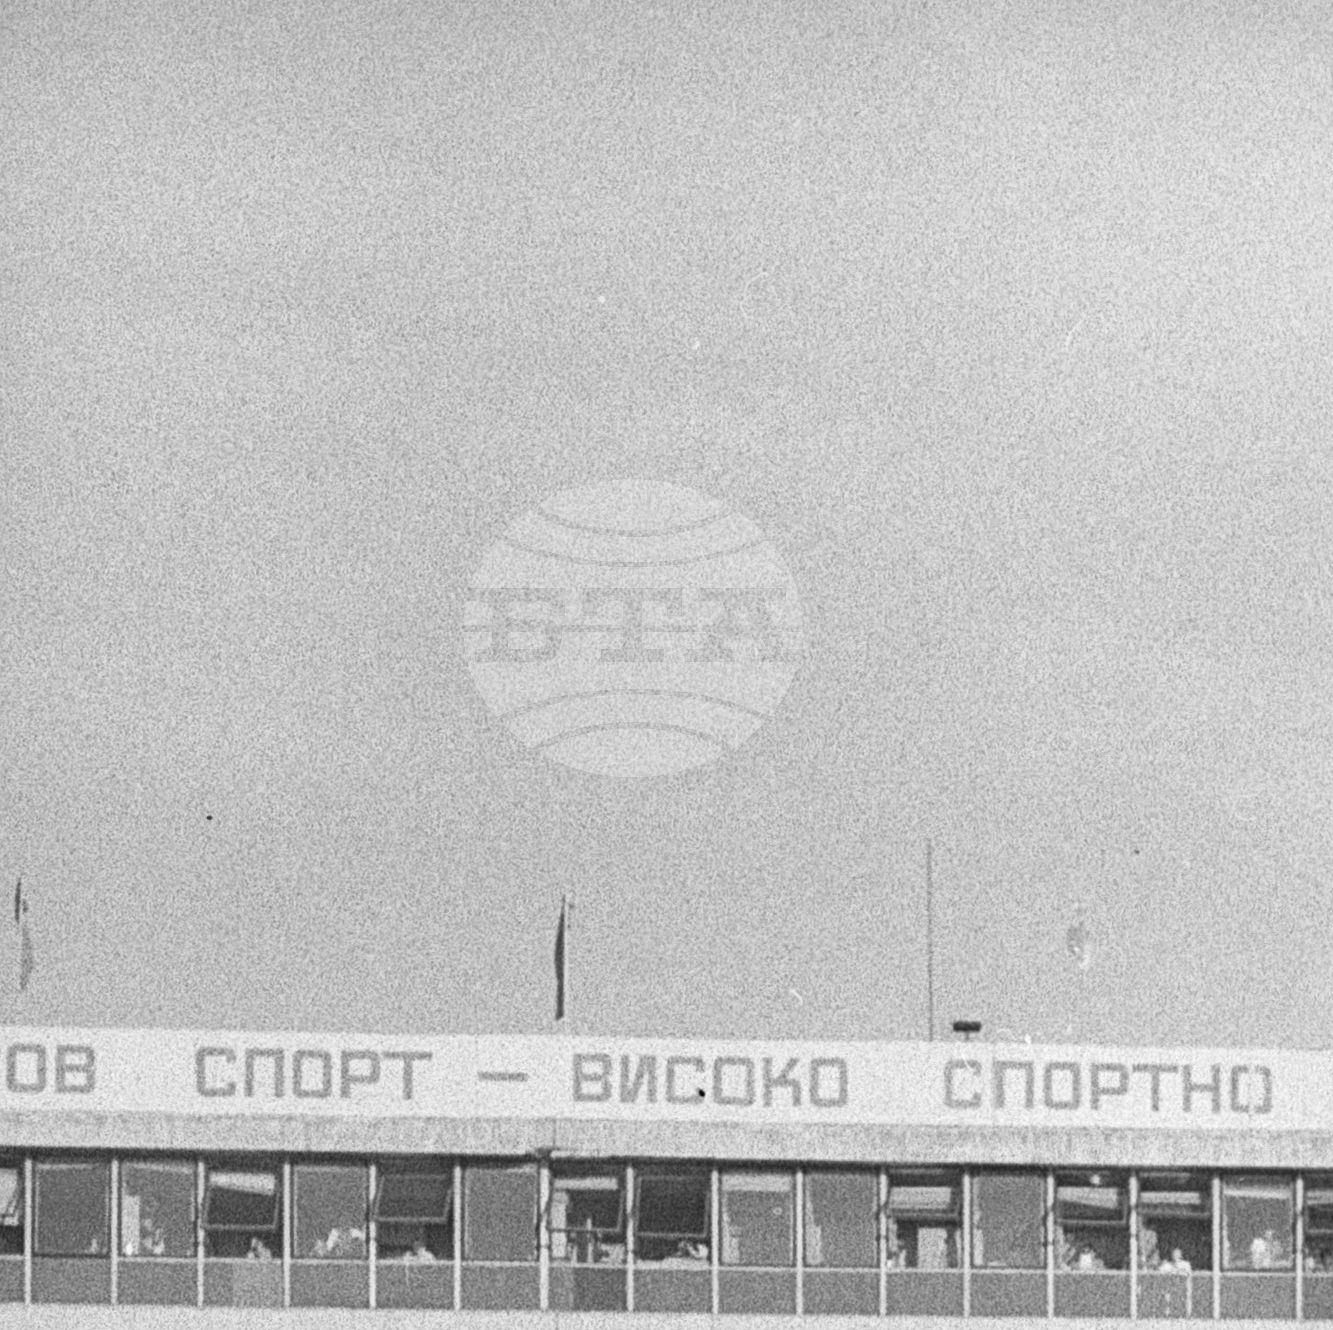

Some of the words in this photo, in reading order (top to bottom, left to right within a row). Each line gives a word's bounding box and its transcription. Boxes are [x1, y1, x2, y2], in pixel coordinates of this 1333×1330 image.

[5, 1043, 96, 1095] ОВ
[194, 1047, 433, 1101] СПОРТ
[572, 1053, 849, 1108] ВИСОКО
[943, 1059, 1273, 1115] СПОРТНО
